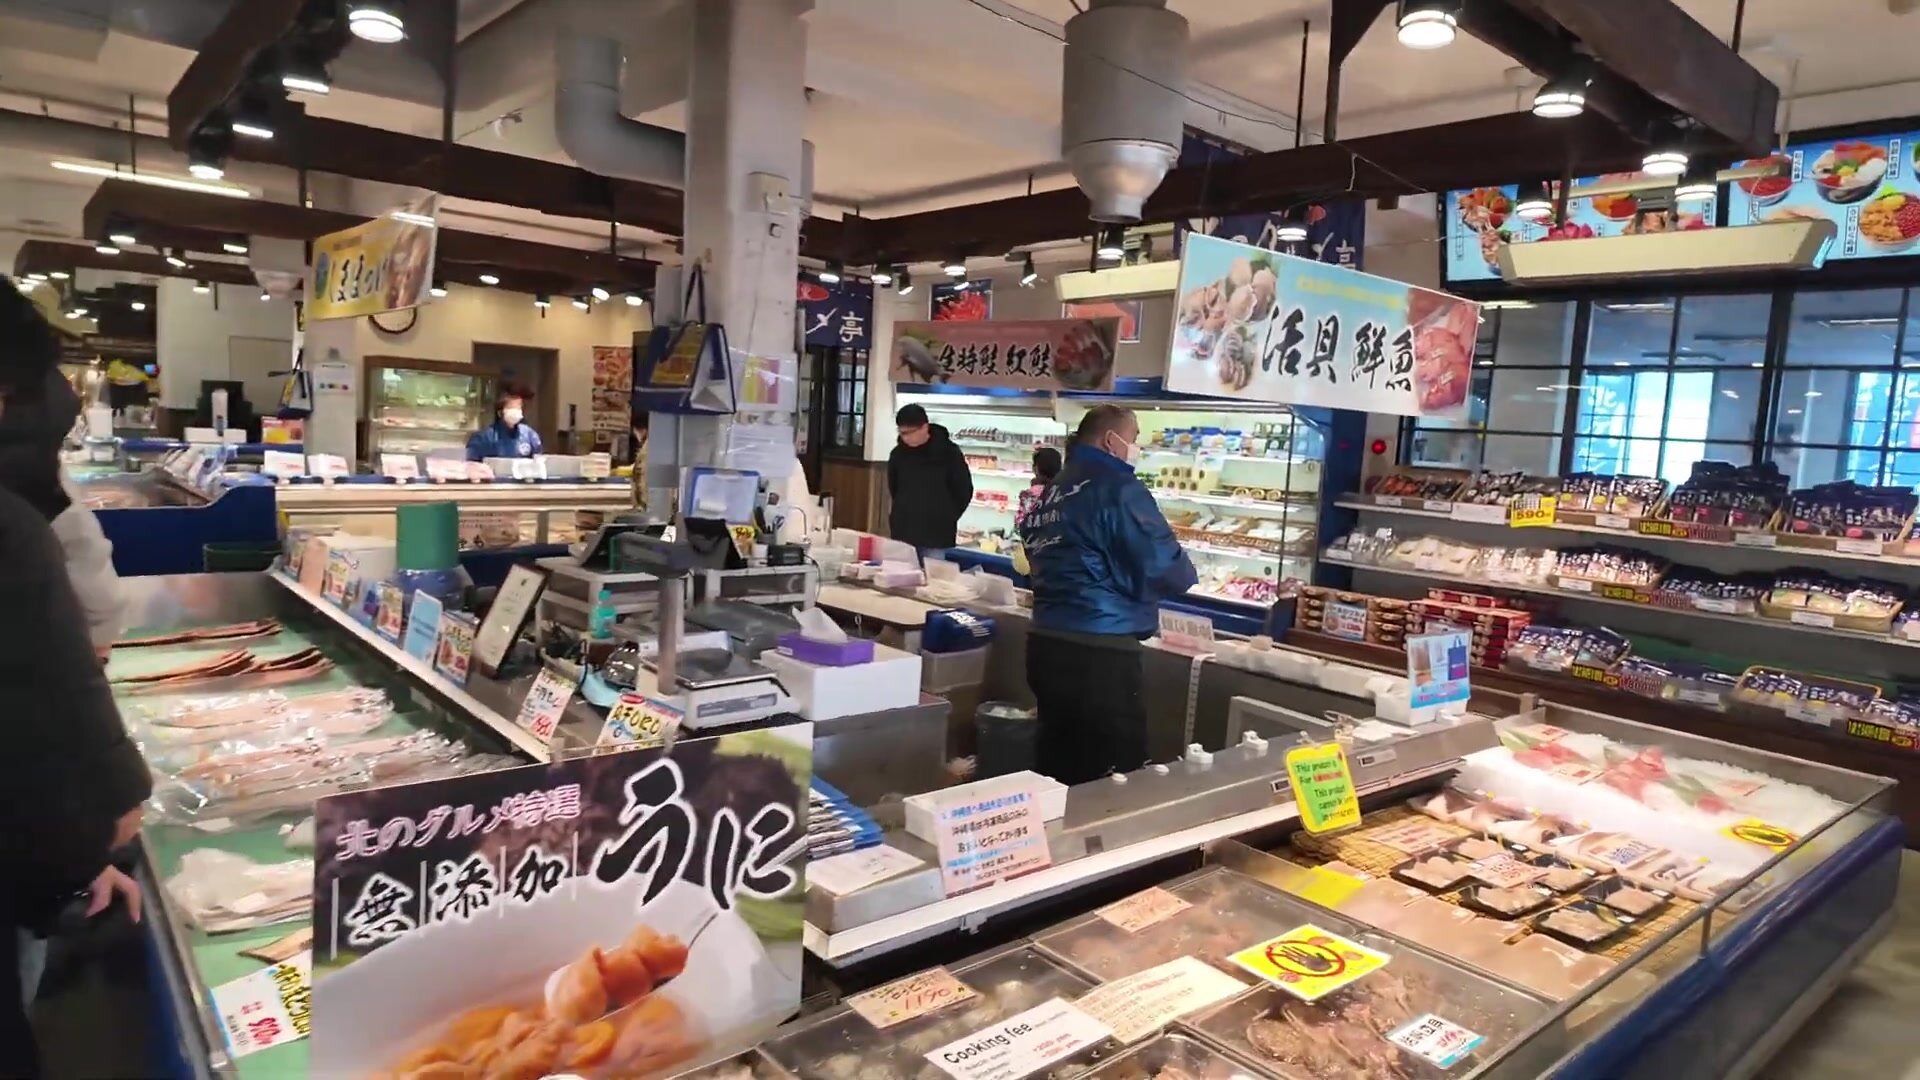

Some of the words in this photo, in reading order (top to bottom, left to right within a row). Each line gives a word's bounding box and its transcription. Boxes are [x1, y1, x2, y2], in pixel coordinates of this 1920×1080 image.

[838, 310, 864, 343] 亭
[1262, 305, 1340, 385] 活貝
[1350, 320, 1416, 393] 鮮魚
[593, 758, 797, 912] うに
[345, 846, 567, 944] 無添加
[943, 1034, 1011, 1063] Cooking
[1004, 1023, 1032, 1038] fee
